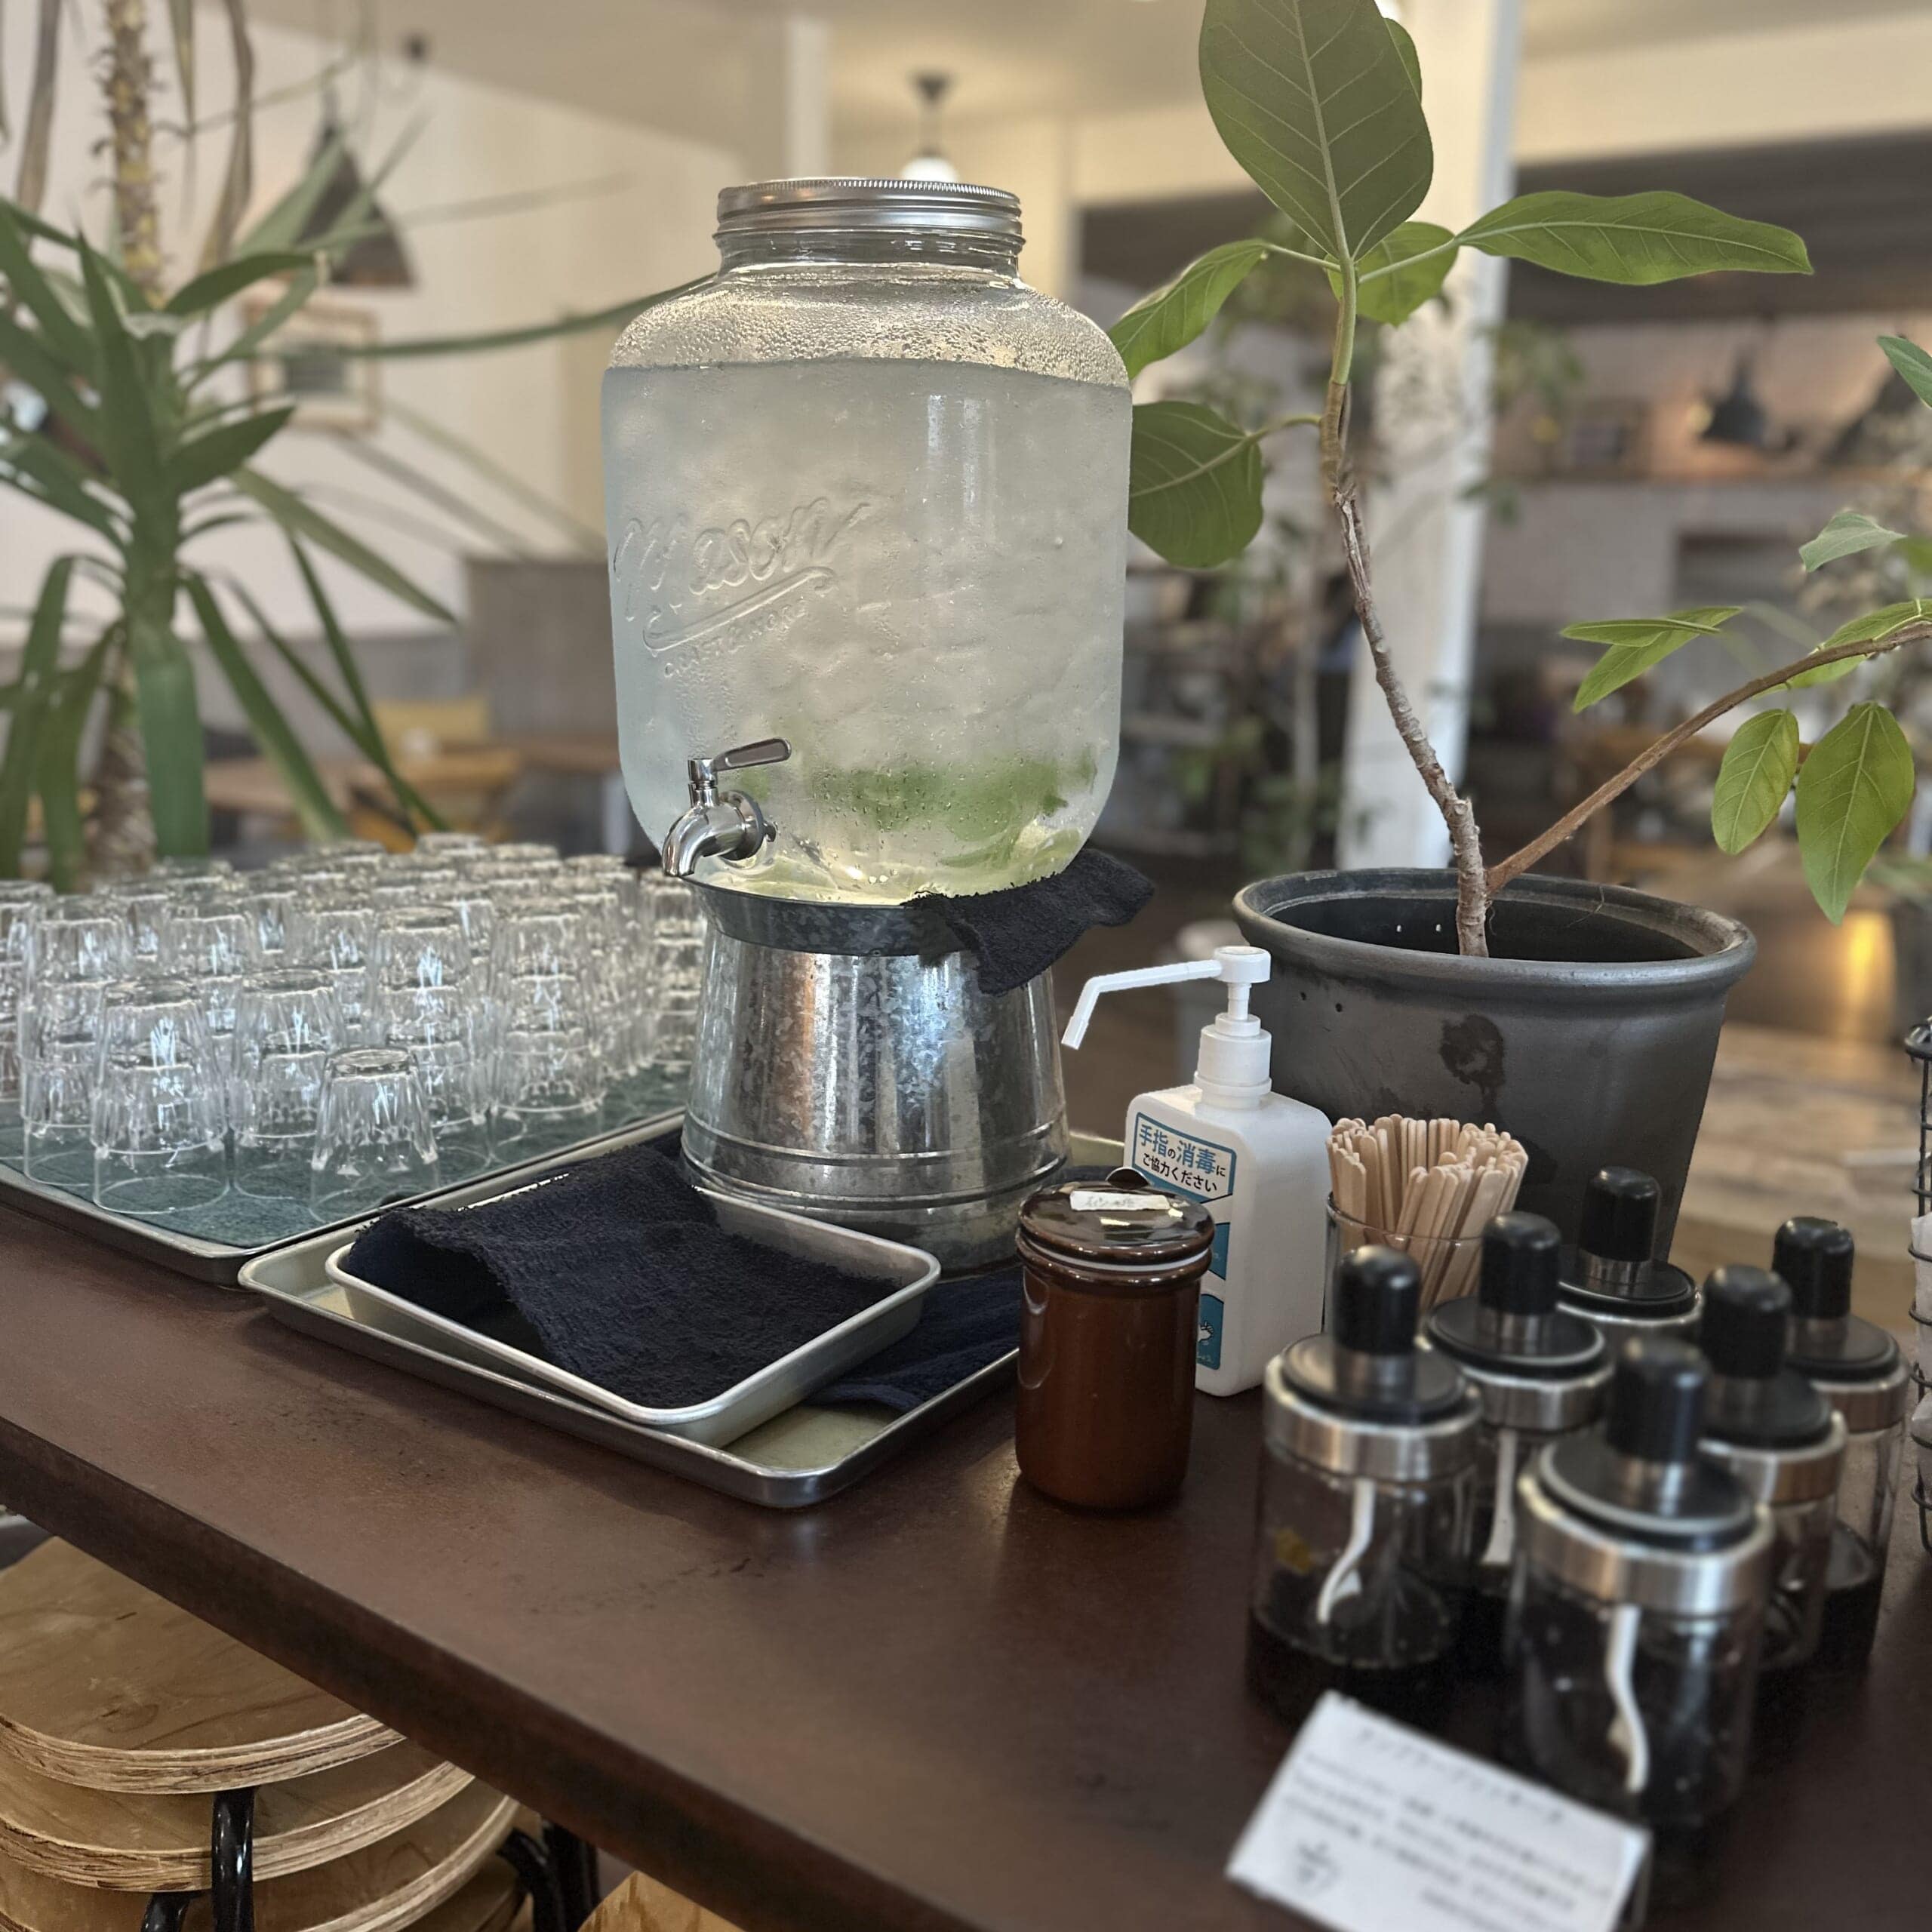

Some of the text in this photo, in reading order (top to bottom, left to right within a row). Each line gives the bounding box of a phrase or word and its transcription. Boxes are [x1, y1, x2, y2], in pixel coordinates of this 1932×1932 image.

[614, 497, 870, 622] Mason
[1139, 1124, 1226, 1177] 手指の消毒に
[1143, 1152, 1217, 1192] ご協力ください
